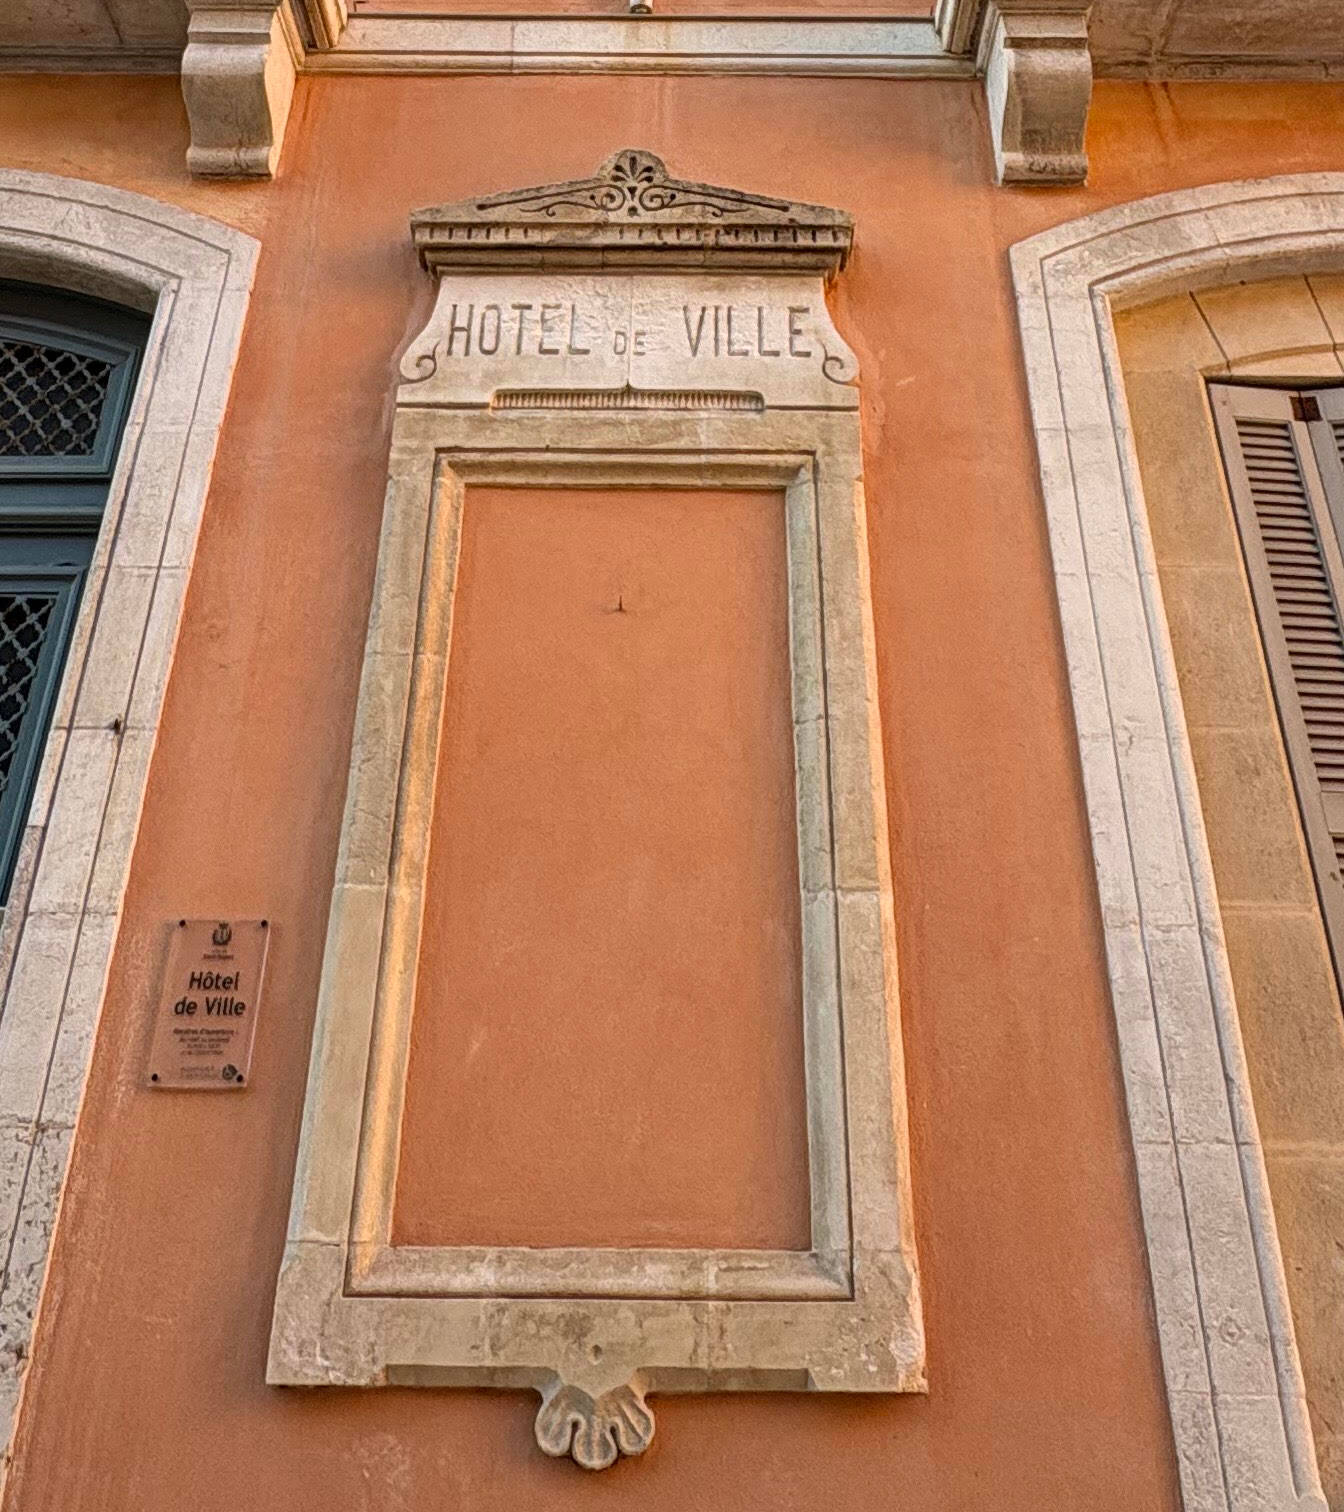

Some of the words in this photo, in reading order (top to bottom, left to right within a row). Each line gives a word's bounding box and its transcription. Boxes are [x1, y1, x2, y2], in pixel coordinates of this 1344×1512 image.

[445, 303, 592, 357] HOTEL
[613, 329, 647, 356] DE
[682, 304, 813, 358] VILLE
[188, 970, 241, 991] Hôtel
[173, 996, 198, 1016] de
[205, 996, 247, 1016] Ville
